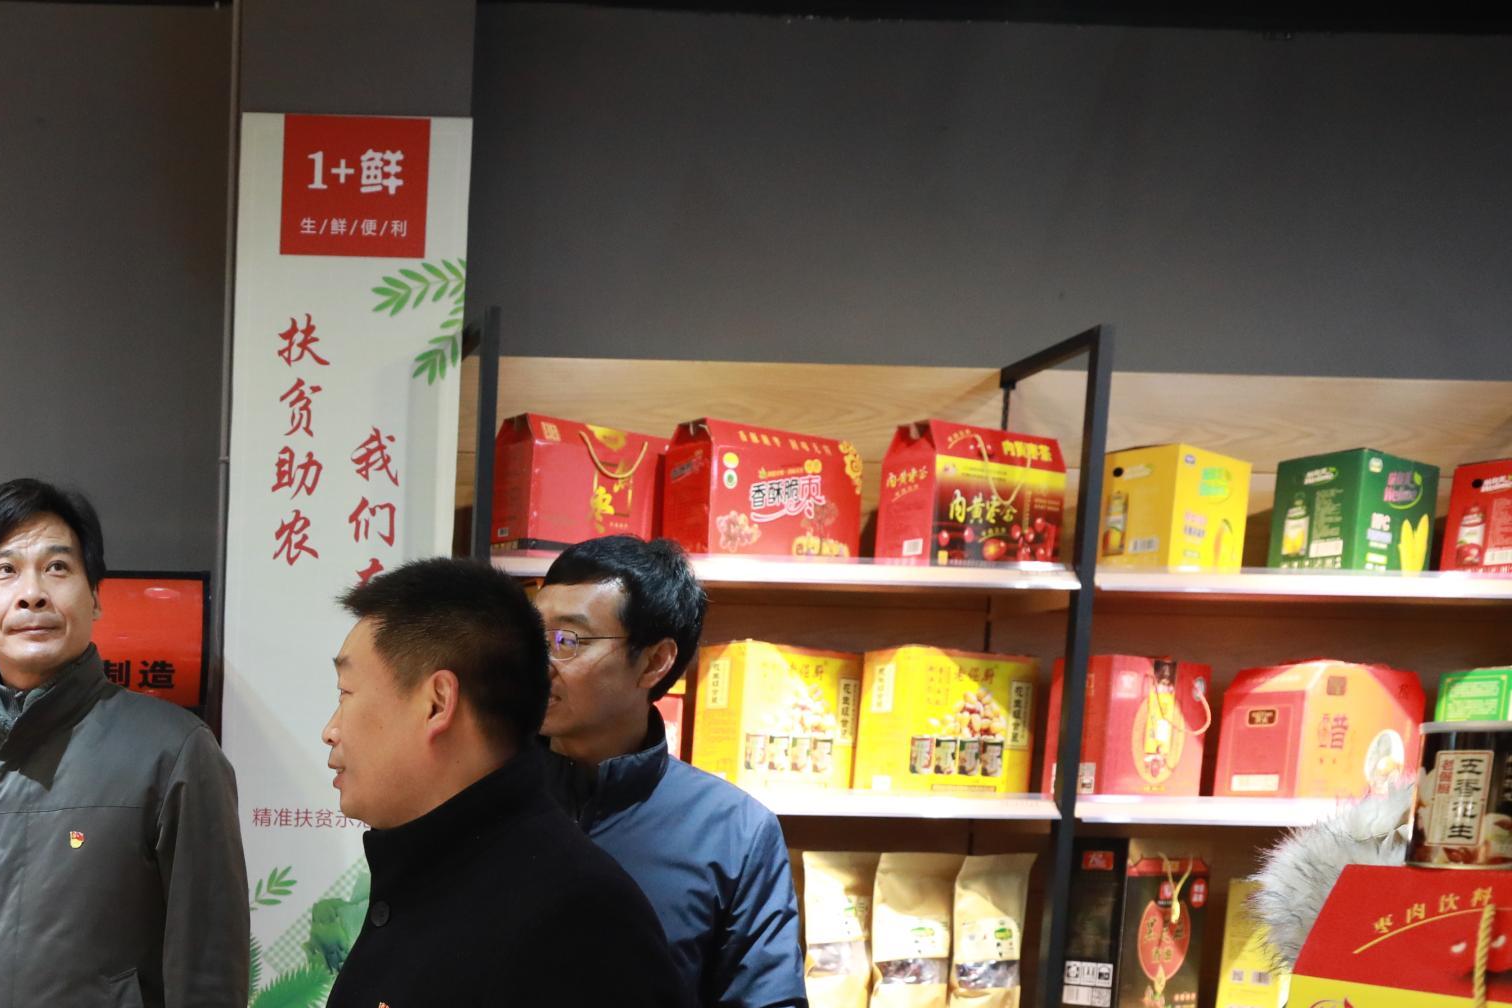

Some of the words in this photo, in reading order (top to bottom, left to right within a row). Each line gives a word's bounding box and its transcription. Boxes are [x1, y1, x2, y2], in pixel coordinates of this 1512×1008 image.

[306, 148, 405, 195] 1+鲜
[271, 312, 331, 567] 扶贫助农
[1447, 758, 1484, 840] 五香花生
